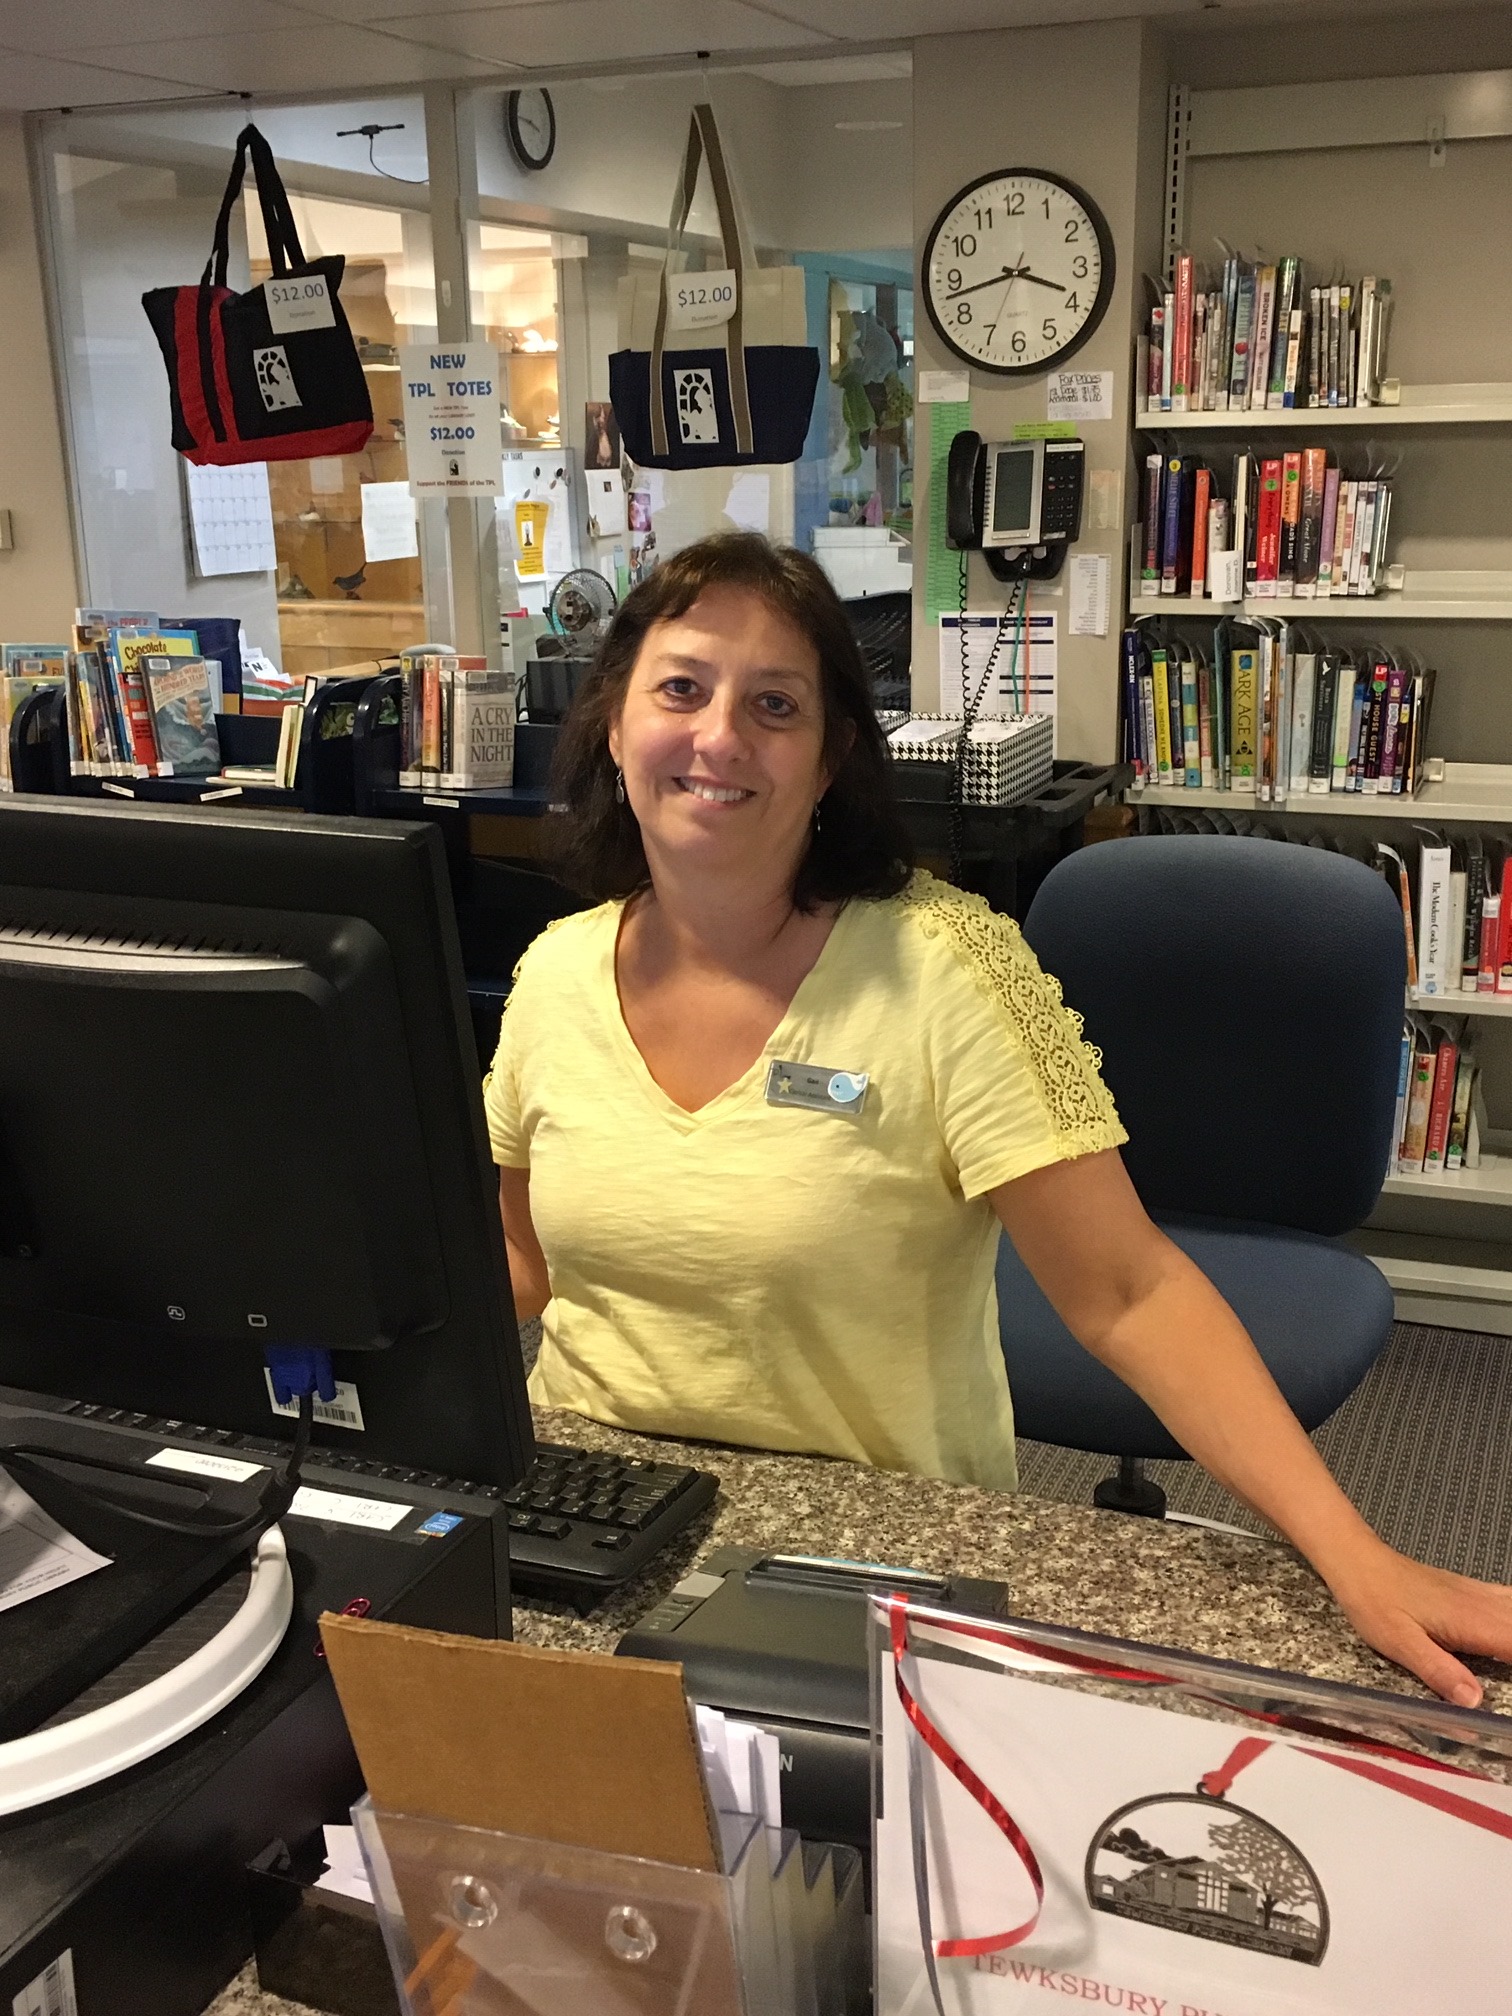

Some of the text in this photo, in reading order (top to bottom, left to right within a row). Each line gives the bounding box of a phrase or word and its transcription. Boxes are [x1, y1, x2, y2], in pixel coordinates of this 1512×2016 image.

[1003, 192, 1025, 216] 12
[1041, 198, 1049, 220] 1
[974, 207, 993, 230] 11
[1064, 220, 1079, 243] 2
[952, 234, 977, 257] 10
[1072, 256, 1088, 278] 3
[947, 268, 962, 291] 9
[271, 283, 324, 305] $12.00
[678, 286, 732, 308] $12.00
[1065, 291, 1080, 313] 4
[957, 302, 972, 325] 8
[1259, 292, 1270, 341] BROKEN ICE
[983, 324, 997, 346] 7
[1042, 318, 1057, 340] 5
[1011, 331, 1026, 353] 6
[430, 354, 466, 370] NEW
[408, 381, 492, 397] TPL TOTES
[430, 427, 475, 441] $12.00
[1266, 462, 1277, 470] LP
[1304, 518, 1312, 539] Great
[1268, 533, 1276, 565] Jennifer
[124, 641, 168, 660] Chocolate
[1128, 655, 1136, 683] NCLEX-RN
[1375, 666, 1387, 674] LP
[1234, 668, 1251, 736] ARK AGE
[471, 707, 484, 725] A
[486, 707, 514, 725] CRY
[1372, 704, 1380, 731] HOUSE
[471, 728, 513, 743] IN THE
[470, 746, 513, 763] NIGHT
[1369, 735, 1377, 762] GUEST
[1428, 881, 1441, 964] The Modern Cook's Year
[1442, 1047, 1452, 1077] Chances
[1433, 1113, 1443, 1146] RICHARD
[972, 1954, 1168, 2016] TEWKSBURY
